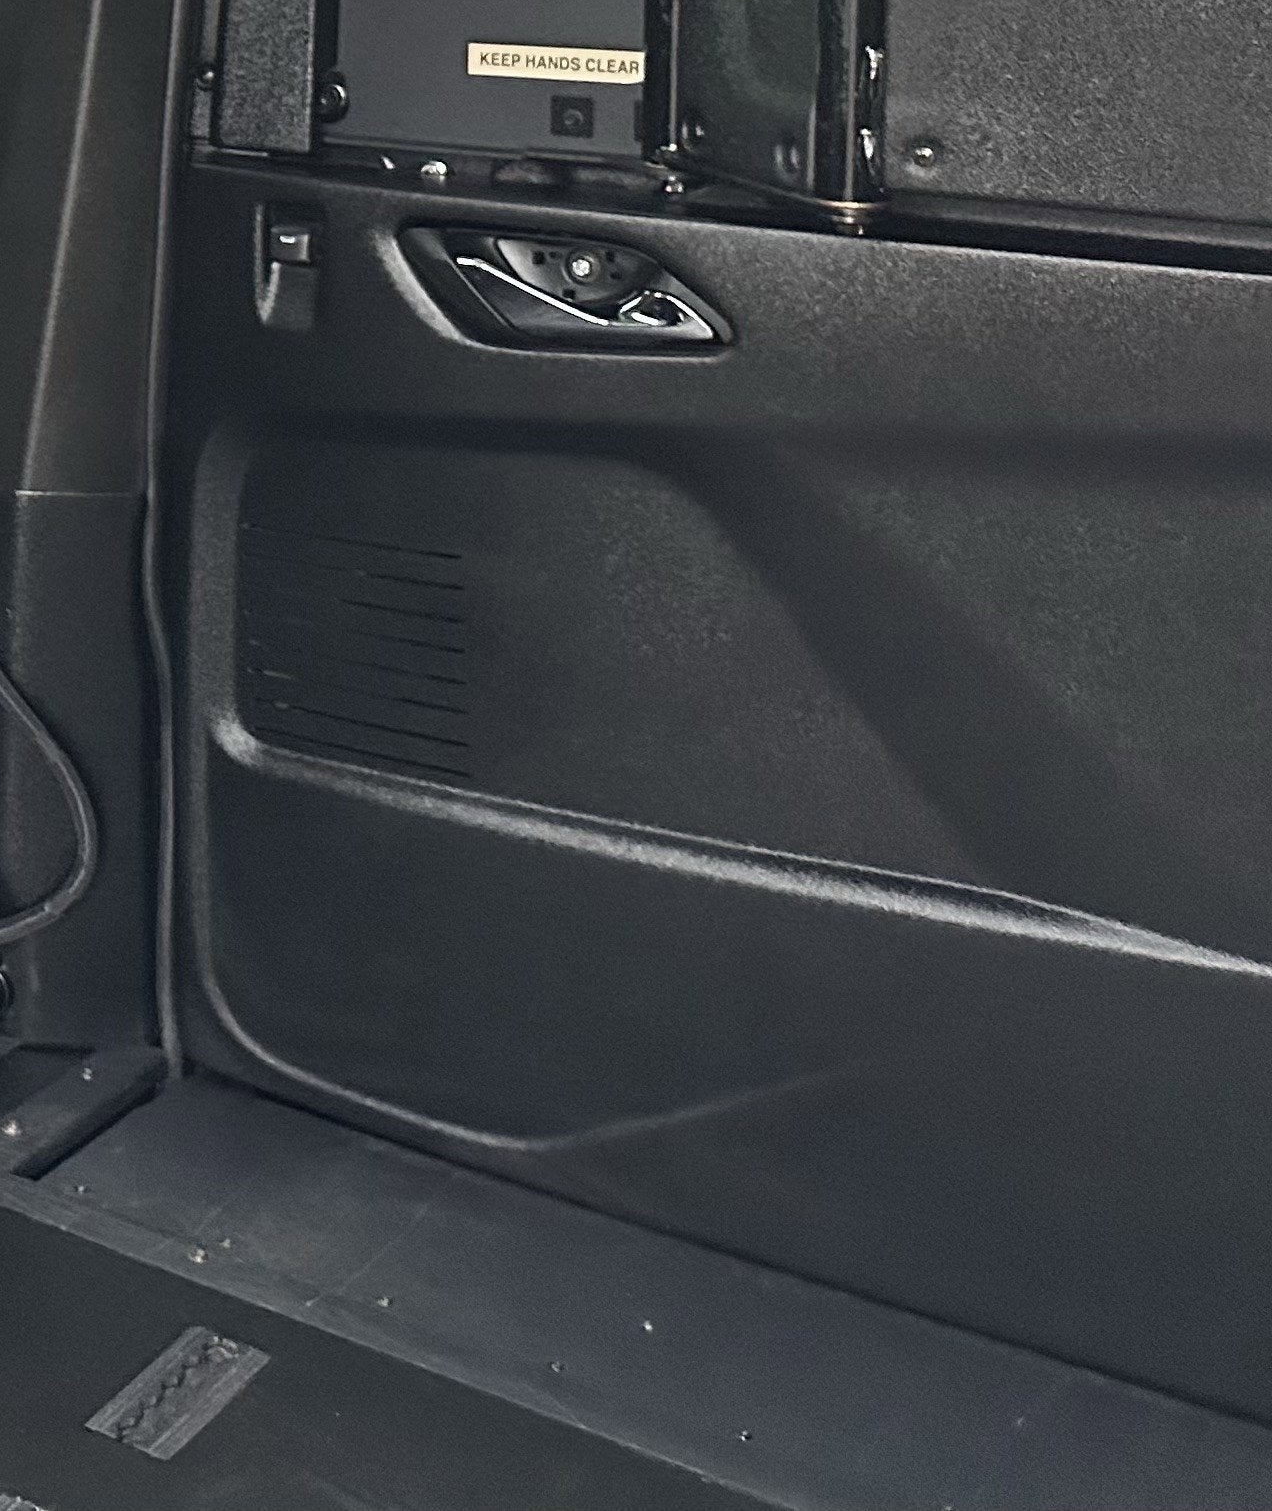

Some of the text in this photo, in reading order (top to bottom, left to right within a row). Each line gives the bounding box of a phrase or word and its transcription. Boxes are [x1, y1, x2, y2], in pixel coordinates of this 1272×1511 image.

[479, 51, 640, 75] KEEP HANDS CLEAR
